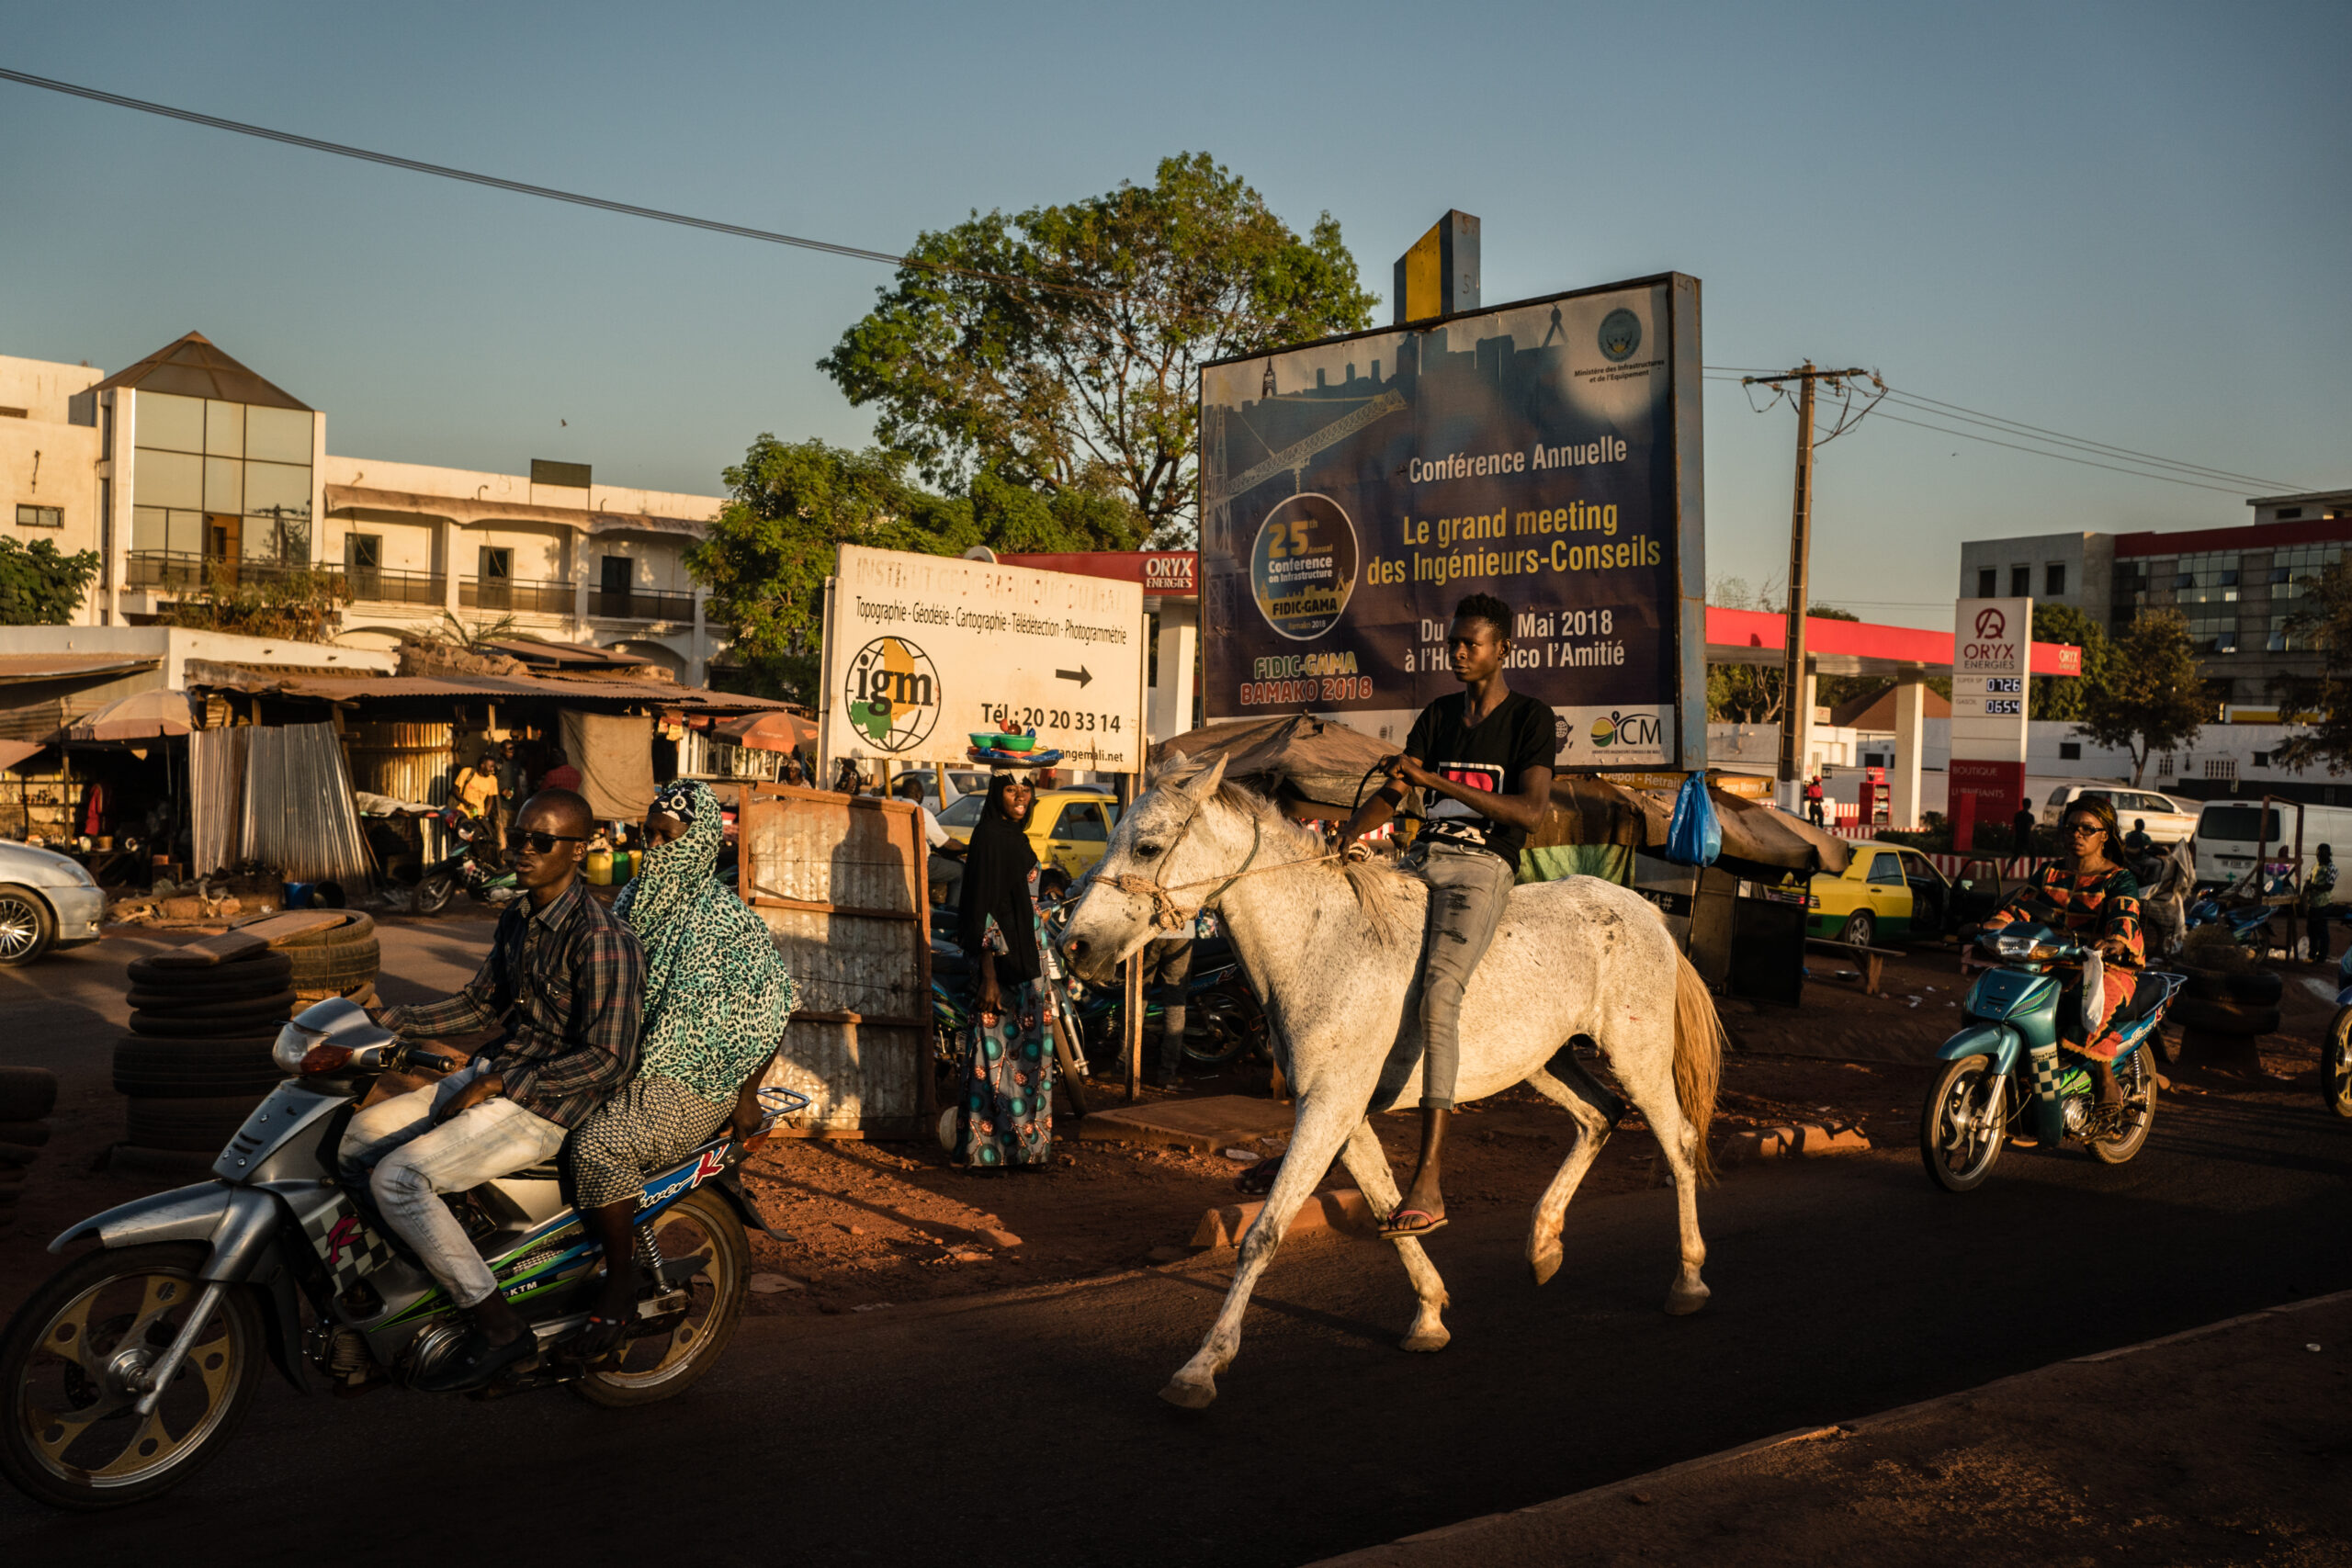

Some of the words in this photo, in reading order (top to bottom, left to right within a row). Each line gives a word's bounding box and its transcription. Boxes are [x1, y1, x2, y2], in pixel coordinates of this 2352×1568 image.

[1605, 366, 1617, 374] des
[1618, 359, 1665, 371] Infrastructures
[1409, 451, 1525, 483] Conférence
[1532, 435, 1627, 470] Annuelle
[1403, 516, 1430, 545] Le
[1438, 507, 1507, 548] grand
[1515, 500, 1618, 536] meeting
[1146, 558, 1193, 577] ORYX
[1269, 557, 1333, 573] Conference
[1367, 556, 1406, 585] des
[1414, 535, 1661, 586] Ingénieurs-Conseils
[1146, 578, 1193, 589] ENERGIES
[1269, 574, 1280, 583] on
[1281, 570, 1332, 582] Infrastructure
[1272, 598, 1338, 615] FIDIC-GAMA
[856, 595, 907, 626] Topographie
[912, 600, 949, 626] Géodésie
[956, 606, 1006, 635] Cartographie
[1012, 612, 1059, 637] Télédétection
[1066, 618, 1127, 647] Photogrammétrie
[1312, 620, 1326, 628] 2018
[1420, 618, 1444, 642] Du
[1517, 612, 1555, 637] Mai
[1561, 609, 1613, 637] 2018
[1405, 648, 1416, 672] à
[1963, 643, 2015, 660] ORYX
[1254, 651, 1358, 680] FIDIC-GAMA
[1964, 660, 2015, 670] ENERGIES
[855, 653, 933, 717] igm
[1240, 679, 1317, 705] BAMAKO
[1321, 675, 1373, 701] 2018
[1987, 679, 2020, 692] 0726
[1986, 700, 2019, 713] 0654
[1023, 707, 1045, 727] 20
[1049, 710, 1070, 729] 20
[1075, 712, 1095, 732] 33
[1101, 714, 1121, 734] 14
[1952, 766, 1997, 777] BOUTIQUE
[1645, 773, 1680, 790] Retrait
[510, 1280, 537, 1296] KTM
